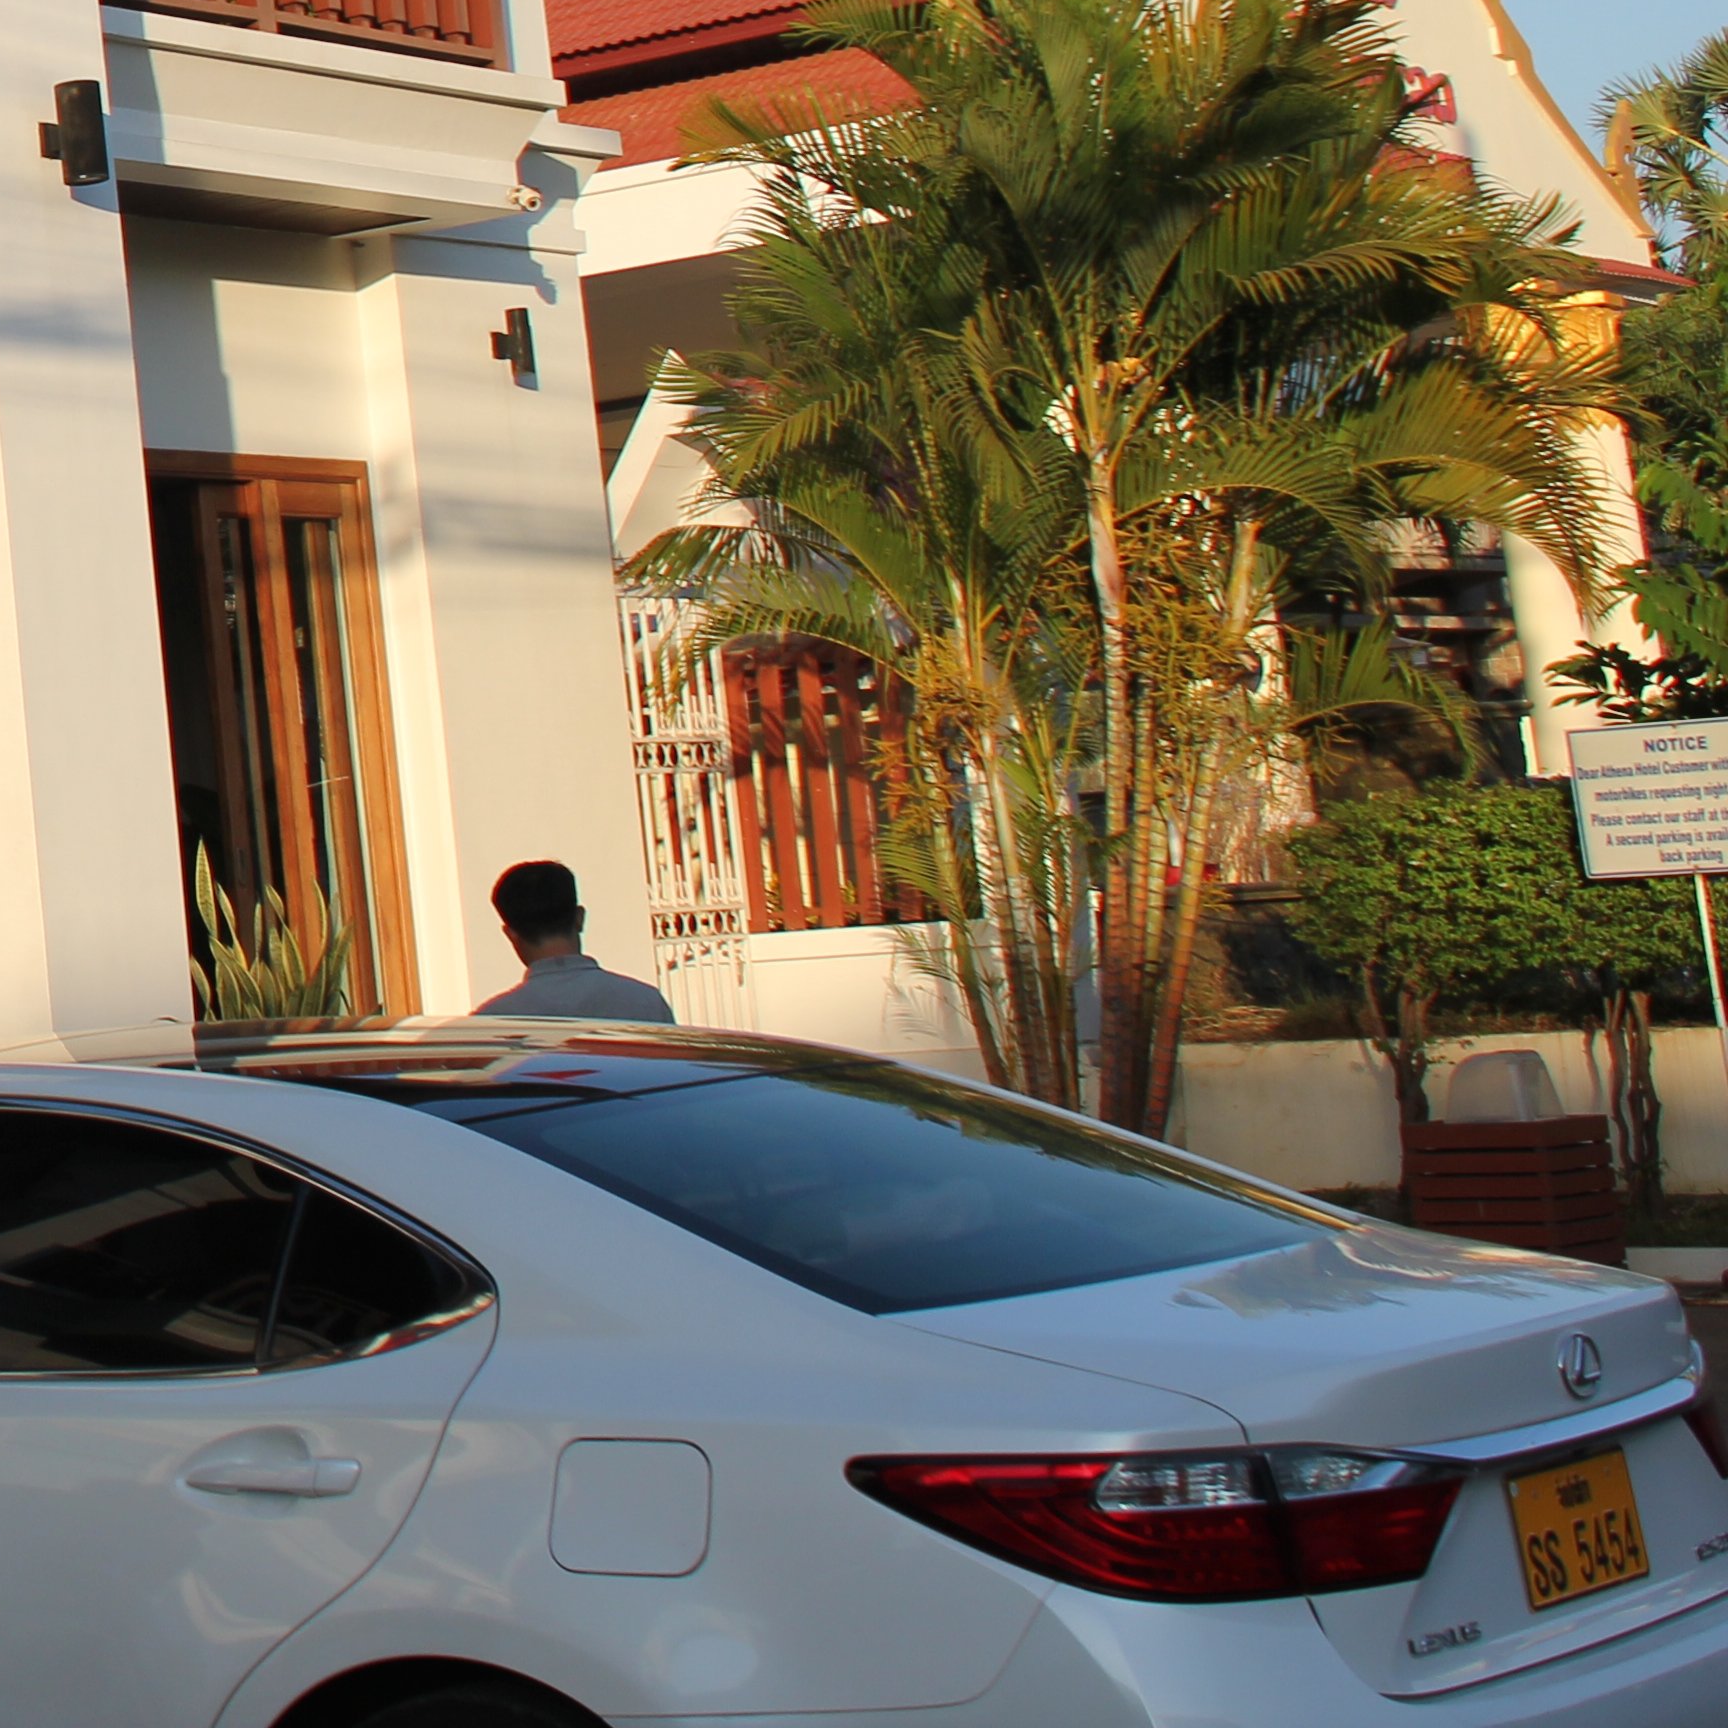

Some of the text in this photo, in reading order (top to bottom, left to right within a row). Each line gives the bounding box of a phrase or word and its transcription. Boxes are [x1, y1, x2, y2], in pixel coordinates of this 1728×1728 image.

[1643, 736, 1707, 752] NOTICE
[1576, 766, 1599, 780] Dear
[1600, 765, 1634, 778] Athena
[1634, 762, 1661, 776] Hotel
[1662, 760, 1709, 774] Customer
[1595, 786, 1647, 801] motorbikes
[1649, 783, 1701, 801] requesting
[1590, 813, 1623, 827] Please
[1625, 811, 1662, 825] contact
[1664, 812, 1680, 823] our
[1683, 807, 1705, 822] staff
[1708, 809, 1718, 821] at
[1606, 833, 1613, 847] A
[1615, 831, 1654, 846] secured
[1655, 830, 1693, 846] parking
[1695, 828, 1704, 842] is
[1659, 847, 1723, 865] back parking
[1526, 1529, 1568, 1597] SS
[1571, 1507, 1640, 1583] 5454
[1406, 1620, 1482, 1660] LEXUS
